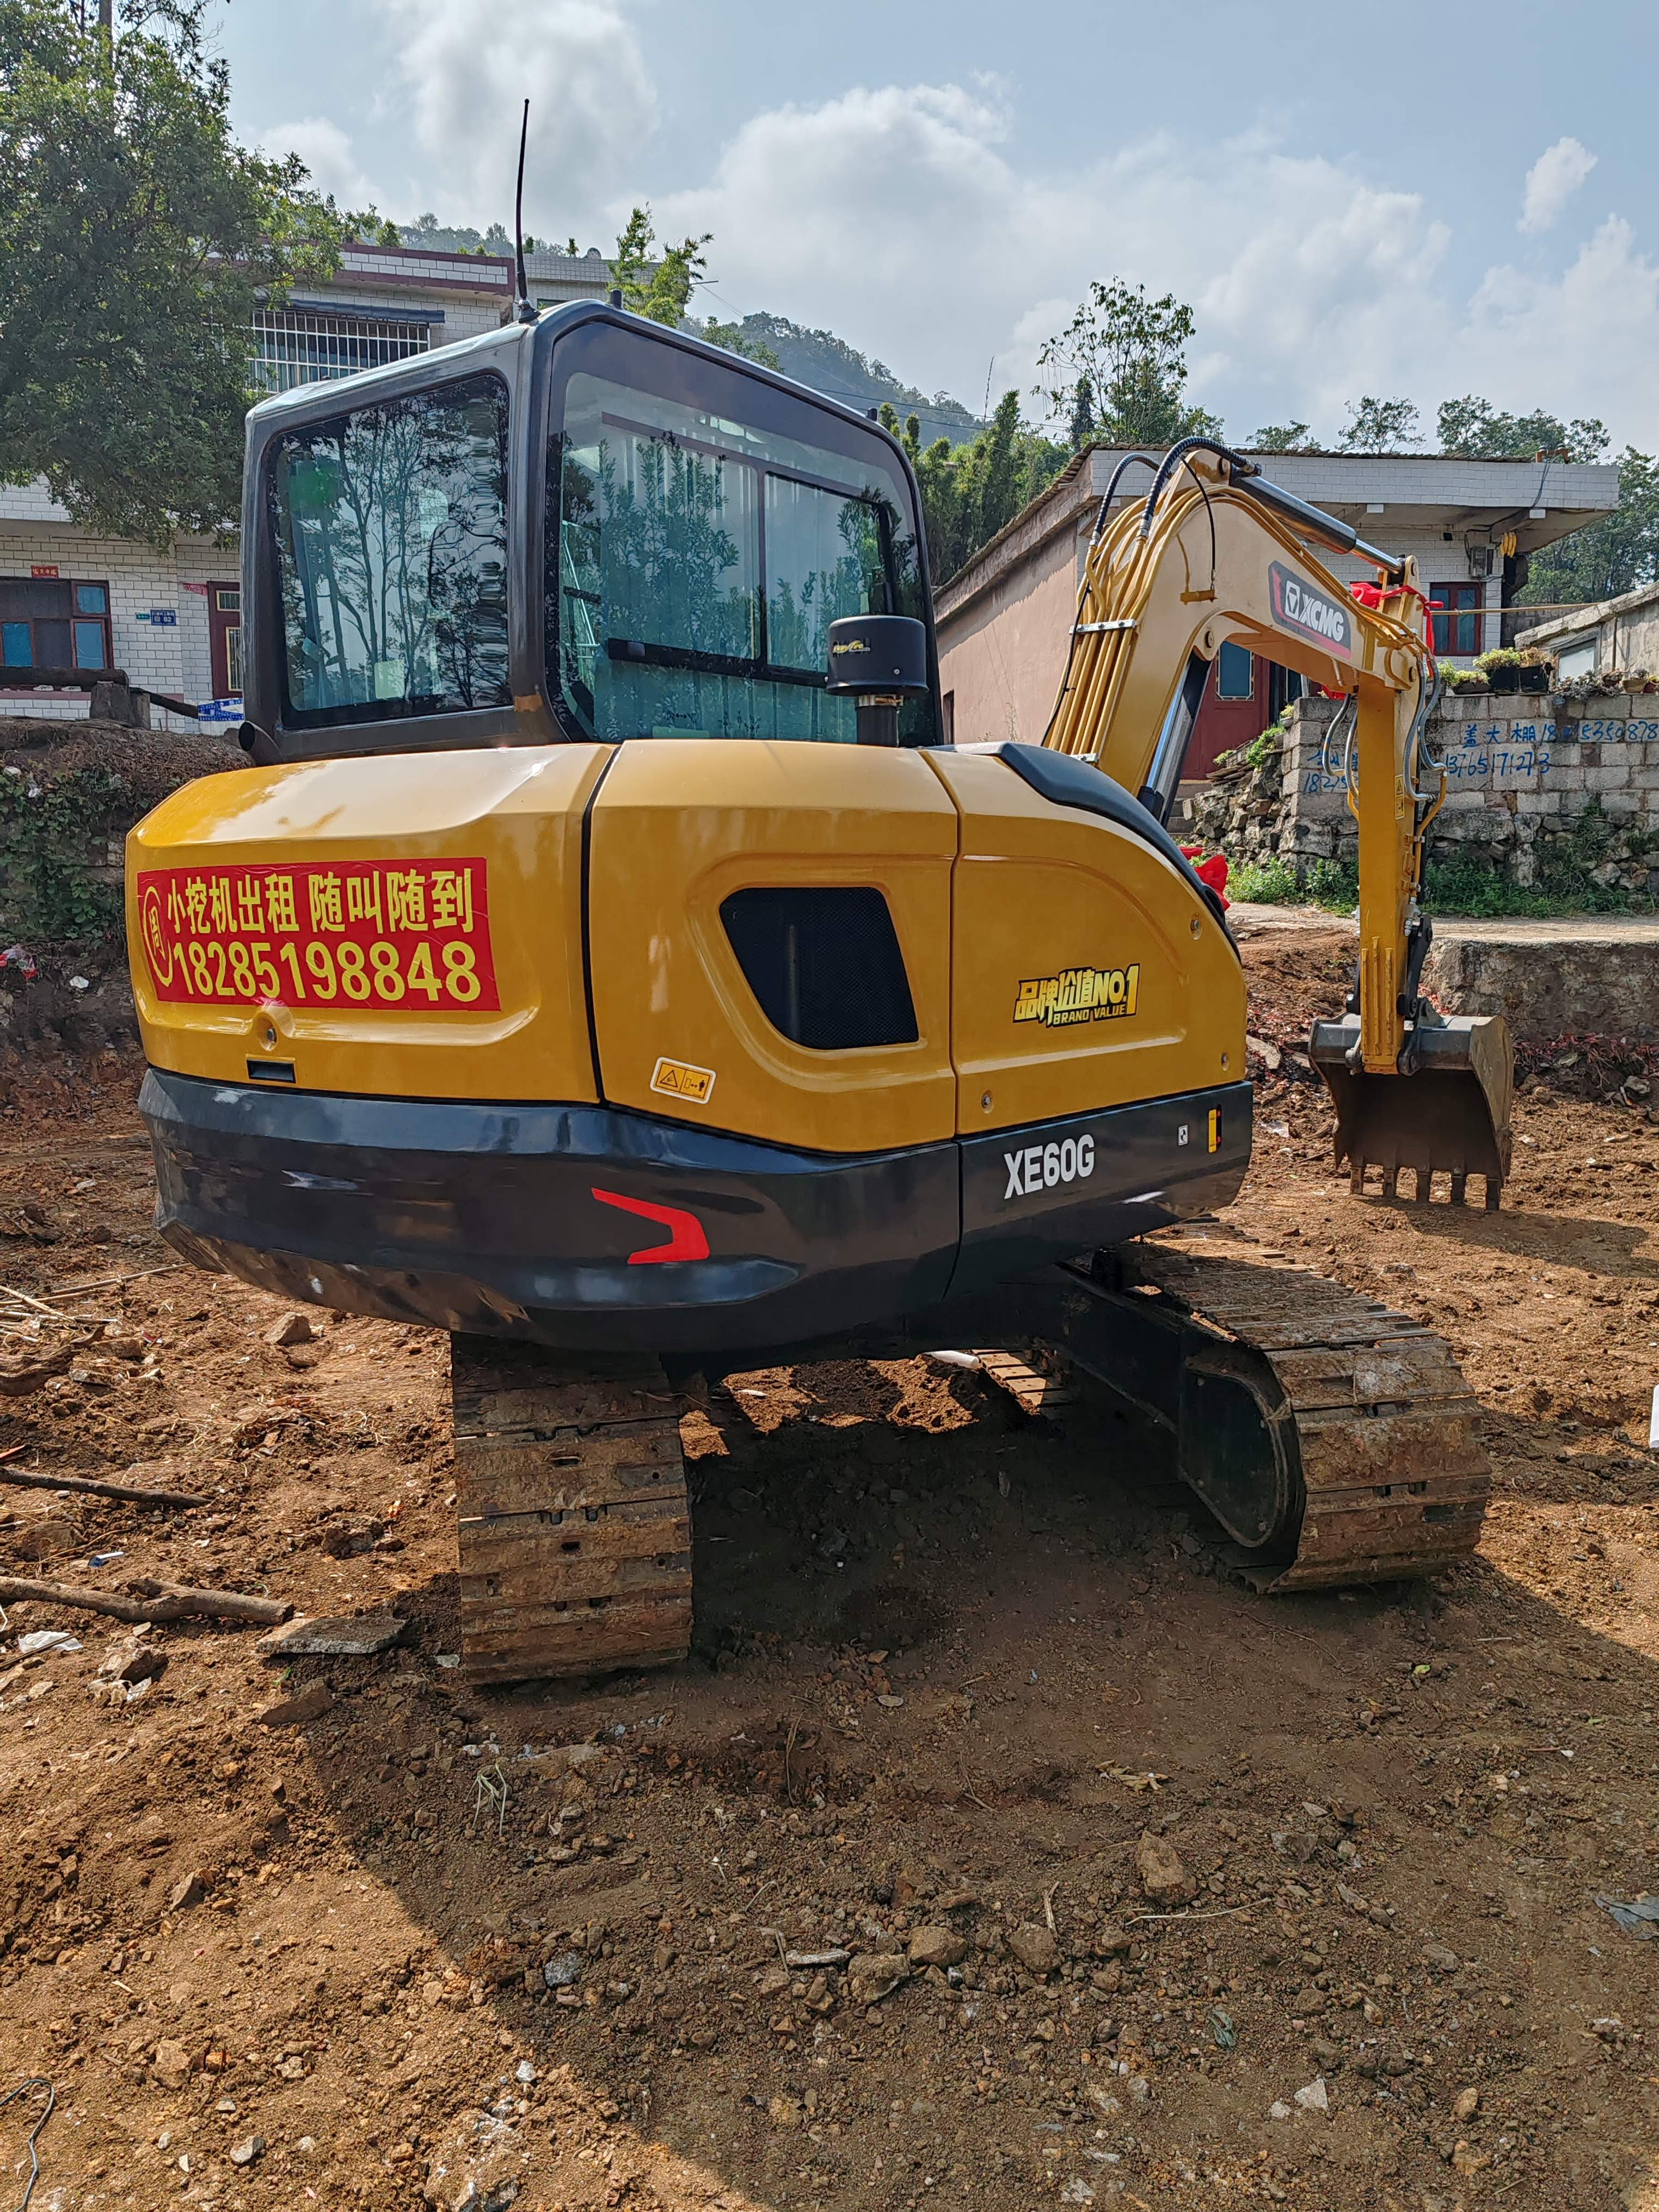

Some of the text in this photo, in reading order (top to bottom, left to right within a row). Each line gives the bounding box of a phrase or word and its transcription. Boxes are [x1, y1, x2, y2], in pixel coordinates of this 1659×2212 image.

[1298, 593, 1344, 642] XCMG
[1462, 722, 1536, 749] 盖大棚
[1446, 751, 1551, 778] 13765171273
[167, 868, 473, 935] 小挖机出租 随叫随到
[173, 941, 481, 1002] 18285198848
[1053, 1004, 1126, 1025] BRAND VALUE
[1004, 1134, 1095, 1200] XE60G
